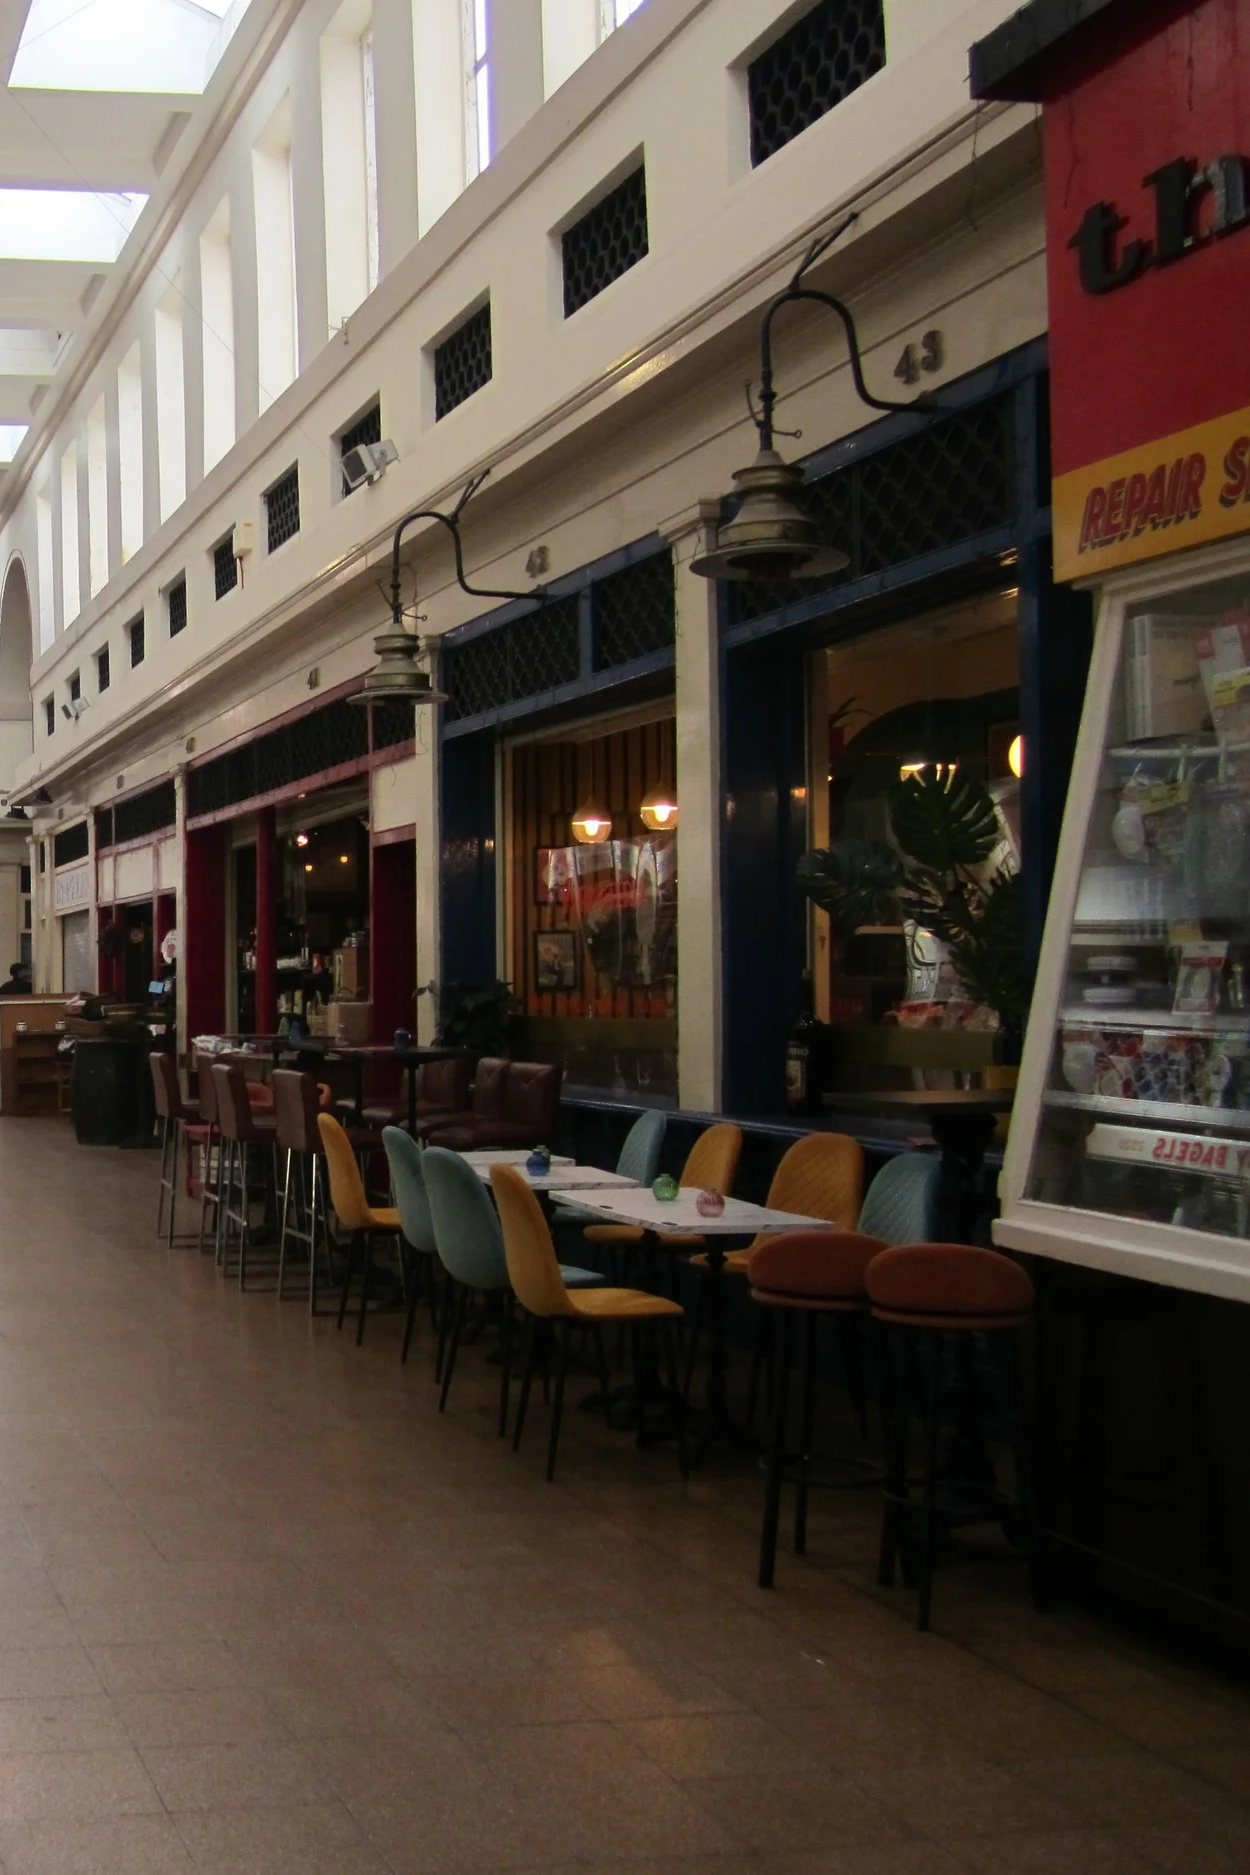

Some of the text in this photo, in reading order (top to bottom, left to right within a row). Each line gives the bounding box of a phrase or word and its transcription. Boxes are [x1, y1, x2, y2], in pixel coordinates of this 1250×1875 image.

[894, 329, 944, 386] 43
[1078, 435, 1250, 555] REPAIR S
